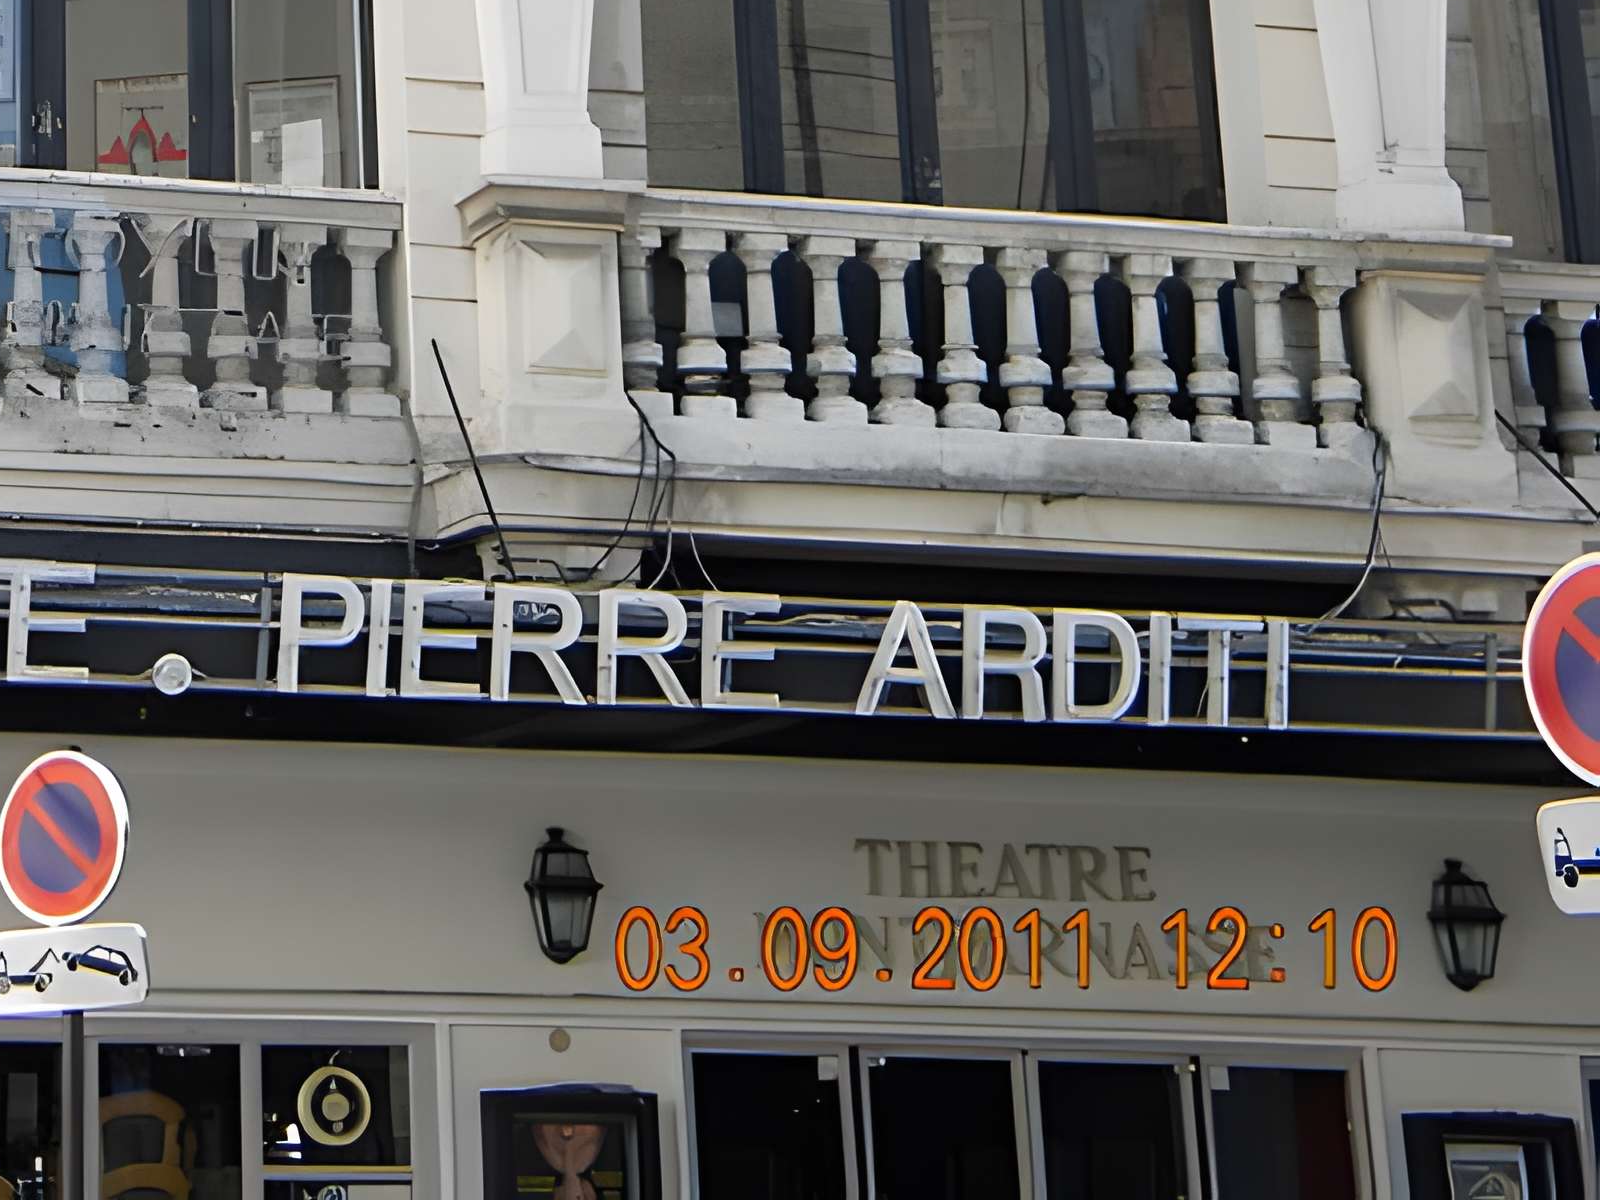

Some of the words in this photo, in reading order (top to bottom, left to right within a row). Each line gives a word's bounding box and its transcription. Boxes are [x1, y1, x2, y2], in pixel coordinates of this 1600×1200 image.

[276, 571, 782, 708] PIERRE
[855, 600, 1289, 730] ARDITI
[854, 837, 1157, 902] THEATRE
